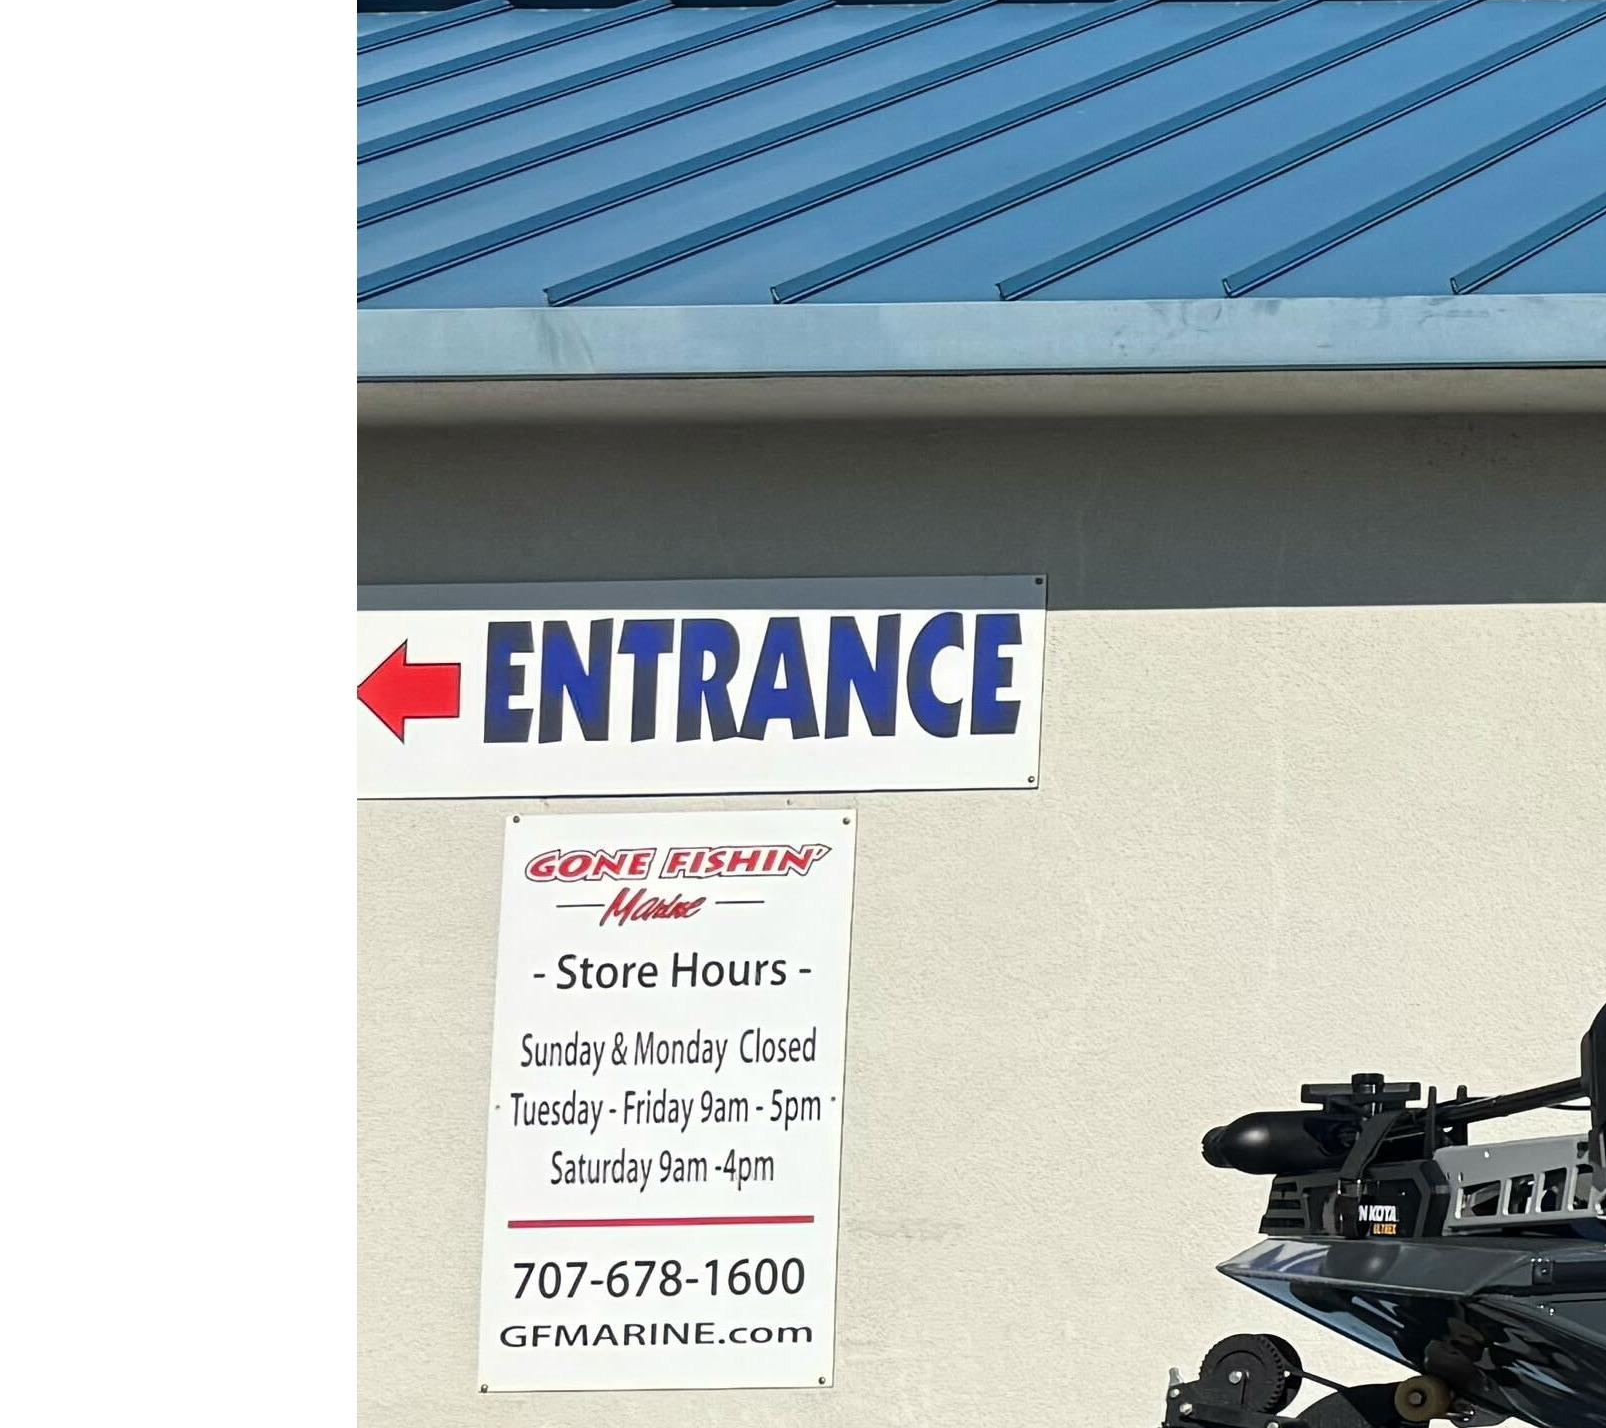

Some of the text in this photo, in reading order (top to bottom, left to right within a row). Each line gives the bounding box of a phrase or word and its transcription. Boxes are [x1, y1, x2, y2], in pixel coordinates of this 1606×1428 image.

[483, 611, 1023, 744] ENTRANCE
[524, 843, 833, 882] GONE FISHIN'
[599, 887, 707, 927] Marine
[556, 953, 658, 990] Store
[671, 951, 787, 988] Hours
[520, 1026, 817, 1077] Sunday & Monday Closed
[510, 1089, 604, 1135] Tuesday
[623, 1088, 694, 1133] Friday
[700, 1090, 749, 1123] 9am
[770, 1088, 821, 1132] 5pm
[550, 1147, 653, 1193] Saturday
[659, 1150, 707, 1183] 9am
[513, 1257, 805, 1299] 707-678-1600
[500, 1322, 812, 1348] GFMARINE.com
